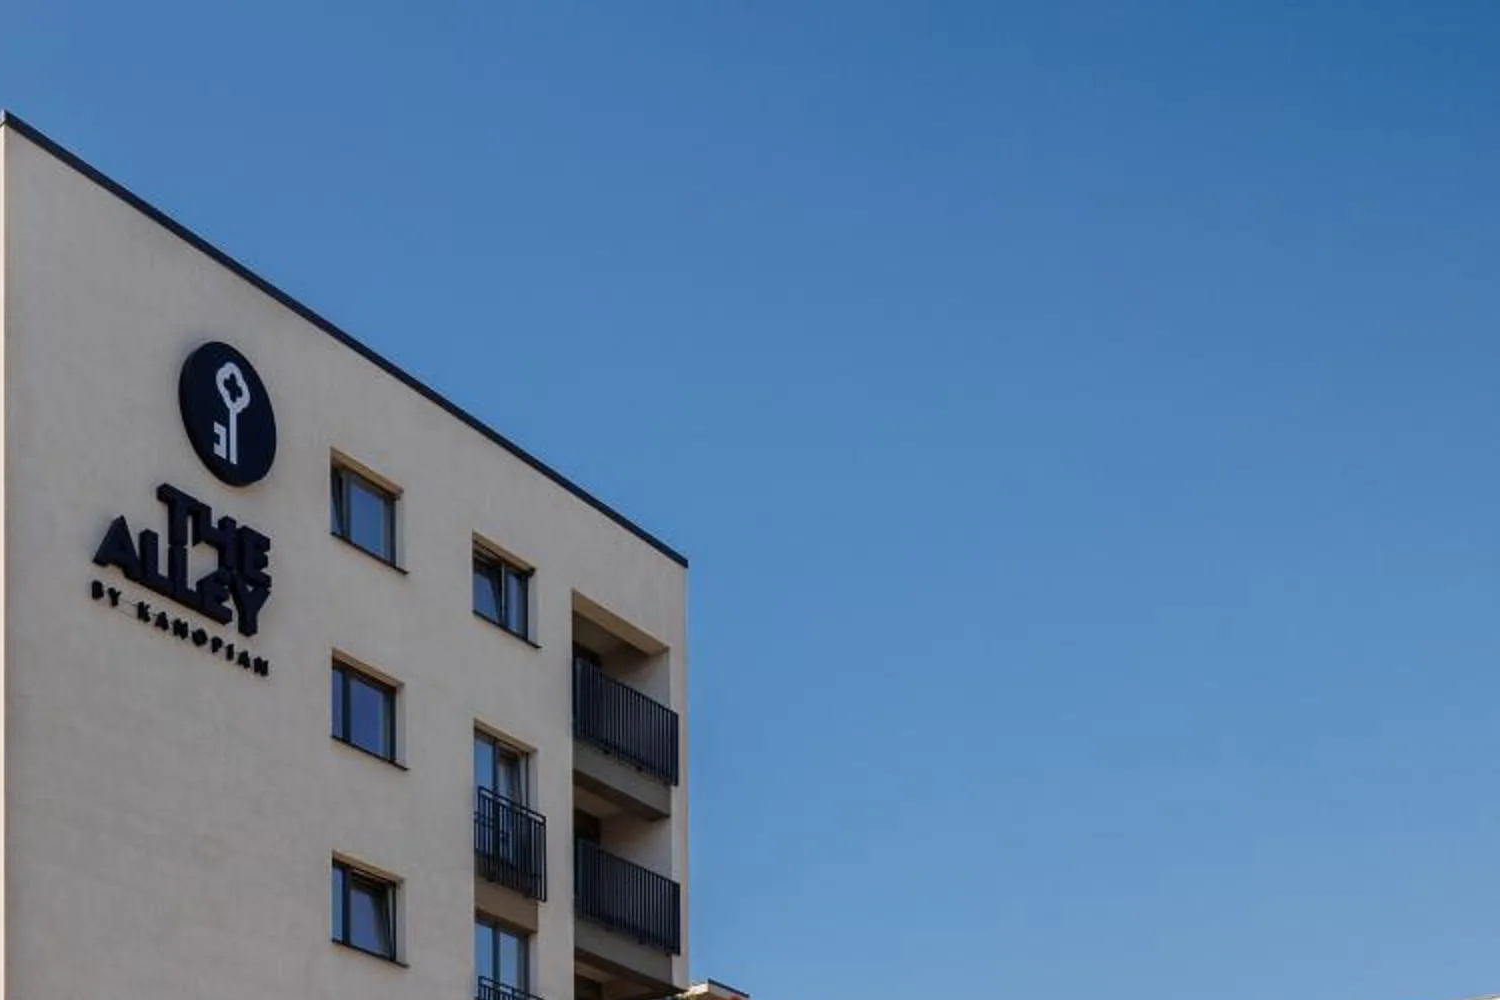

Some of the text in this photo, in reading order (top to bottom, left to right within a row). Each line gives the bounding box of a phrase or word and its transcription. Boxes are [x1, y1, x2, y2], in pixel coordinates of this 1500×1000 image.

[93, 515, 271, 637] ALLEY
[156, 483, 272, 589] THE
[92, 580, 269, 676] BY KANOPIAN
